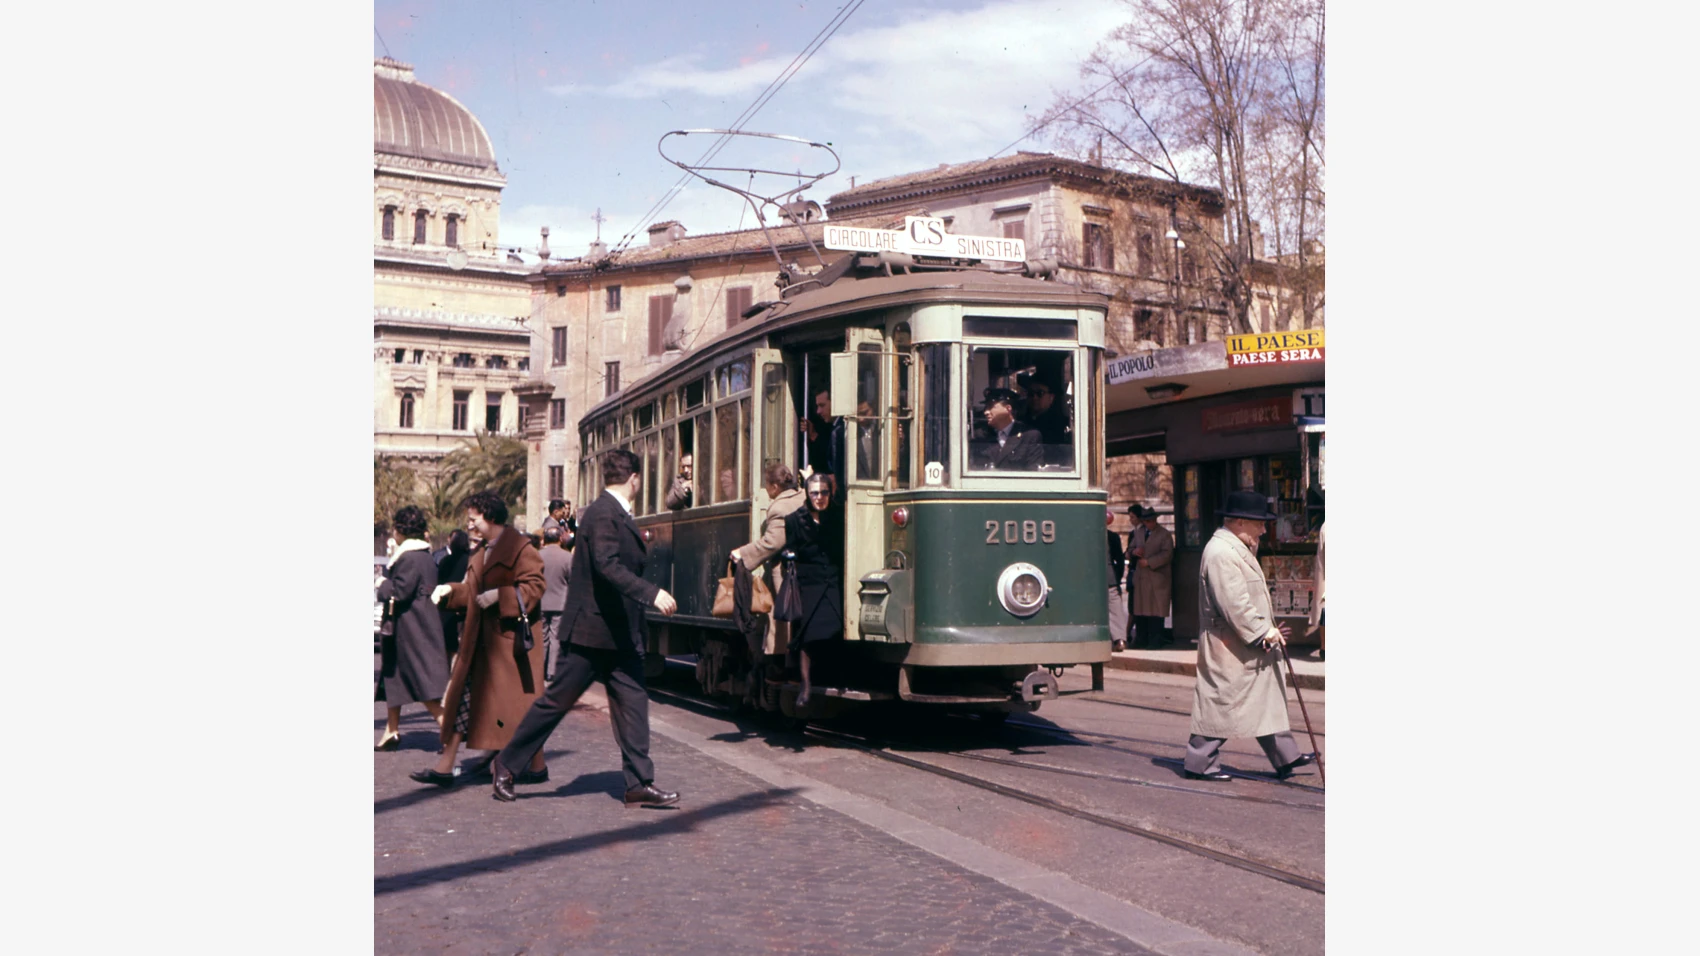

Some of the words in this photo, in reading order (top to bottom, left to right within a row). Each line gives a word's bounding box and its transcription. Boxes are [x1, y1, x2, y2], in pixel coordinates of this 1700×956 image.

[829, 228, 898, 250] CIRCOLARE
[957, 237, 1022, 259] SINISTRA
[910, 219, 943, 246] CS
[1231, 338, 1251, 351] IL
[1257, 332, 1320, 350] PAESE
[1108, 360, 1119, 379] IL
[1119, 354, 1155, 377] POPOLO
[1232, 351, 1277, 366] PAESE
[1280, 348, 1322, 362] SERA
[928, 468, 940, 479] 10
[985, 520, 1056, 544] 2089
